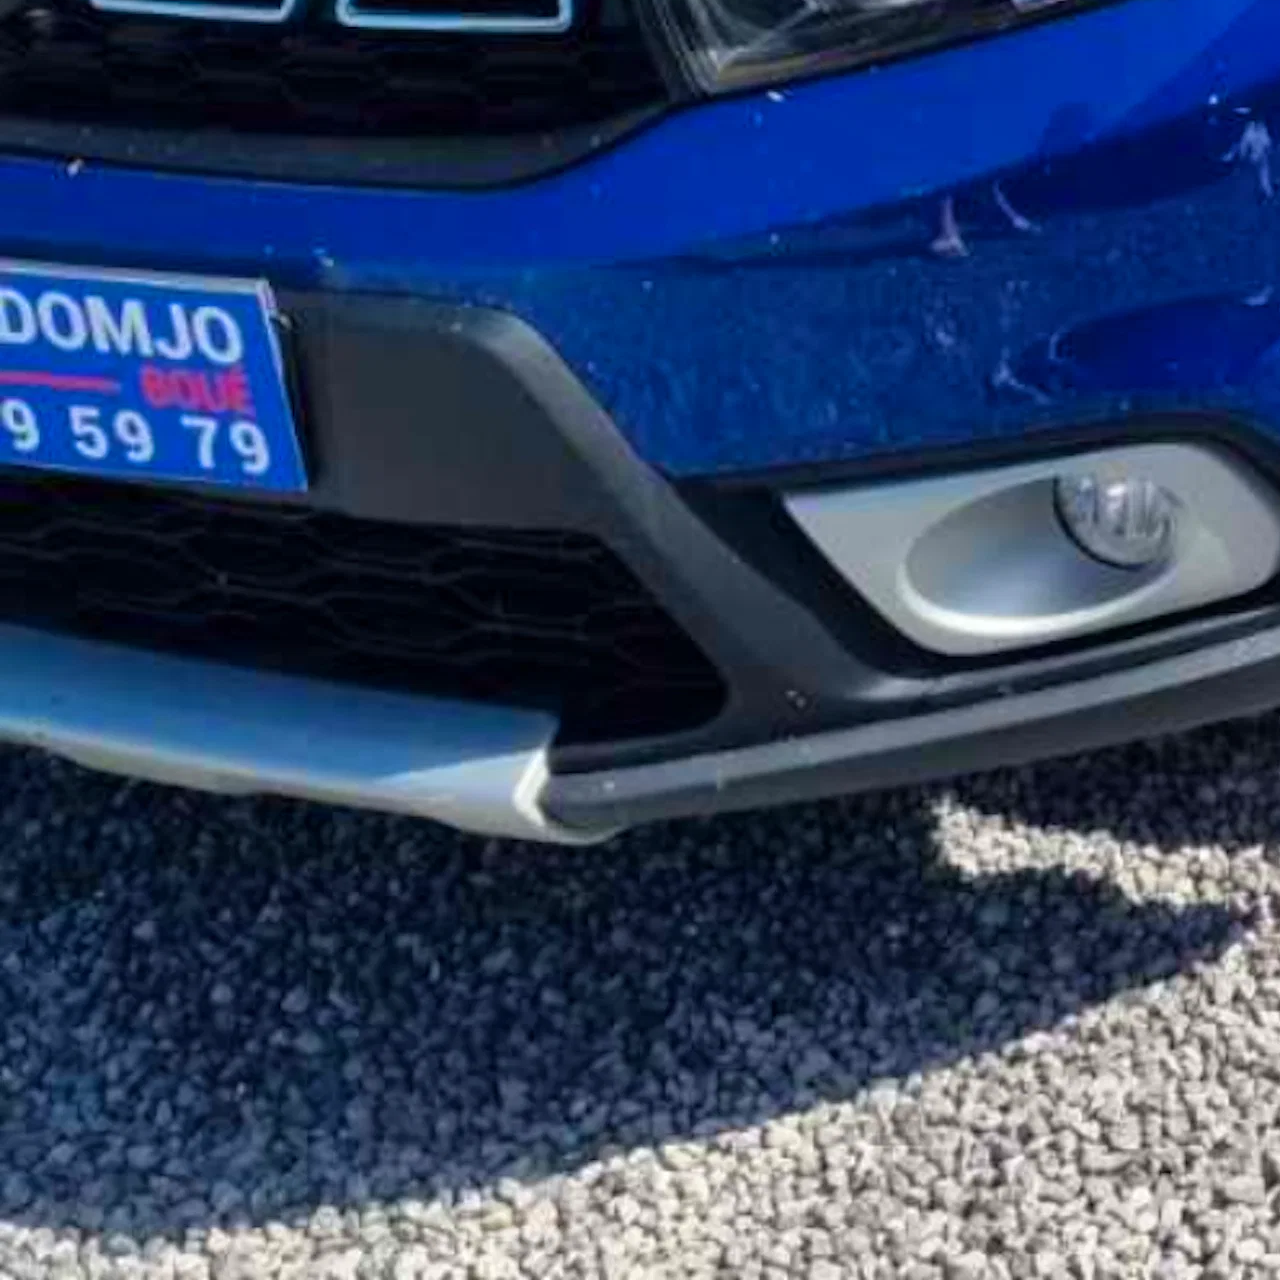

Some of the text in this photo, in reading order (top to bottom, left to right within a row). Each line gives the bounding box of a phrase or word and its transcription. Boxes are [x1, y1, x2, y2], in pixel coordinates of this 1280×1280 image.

[0, 289, 243, 363] DOMJO
[69, 405, 153, 463] 59
[181, 414, 269, 474] 79
